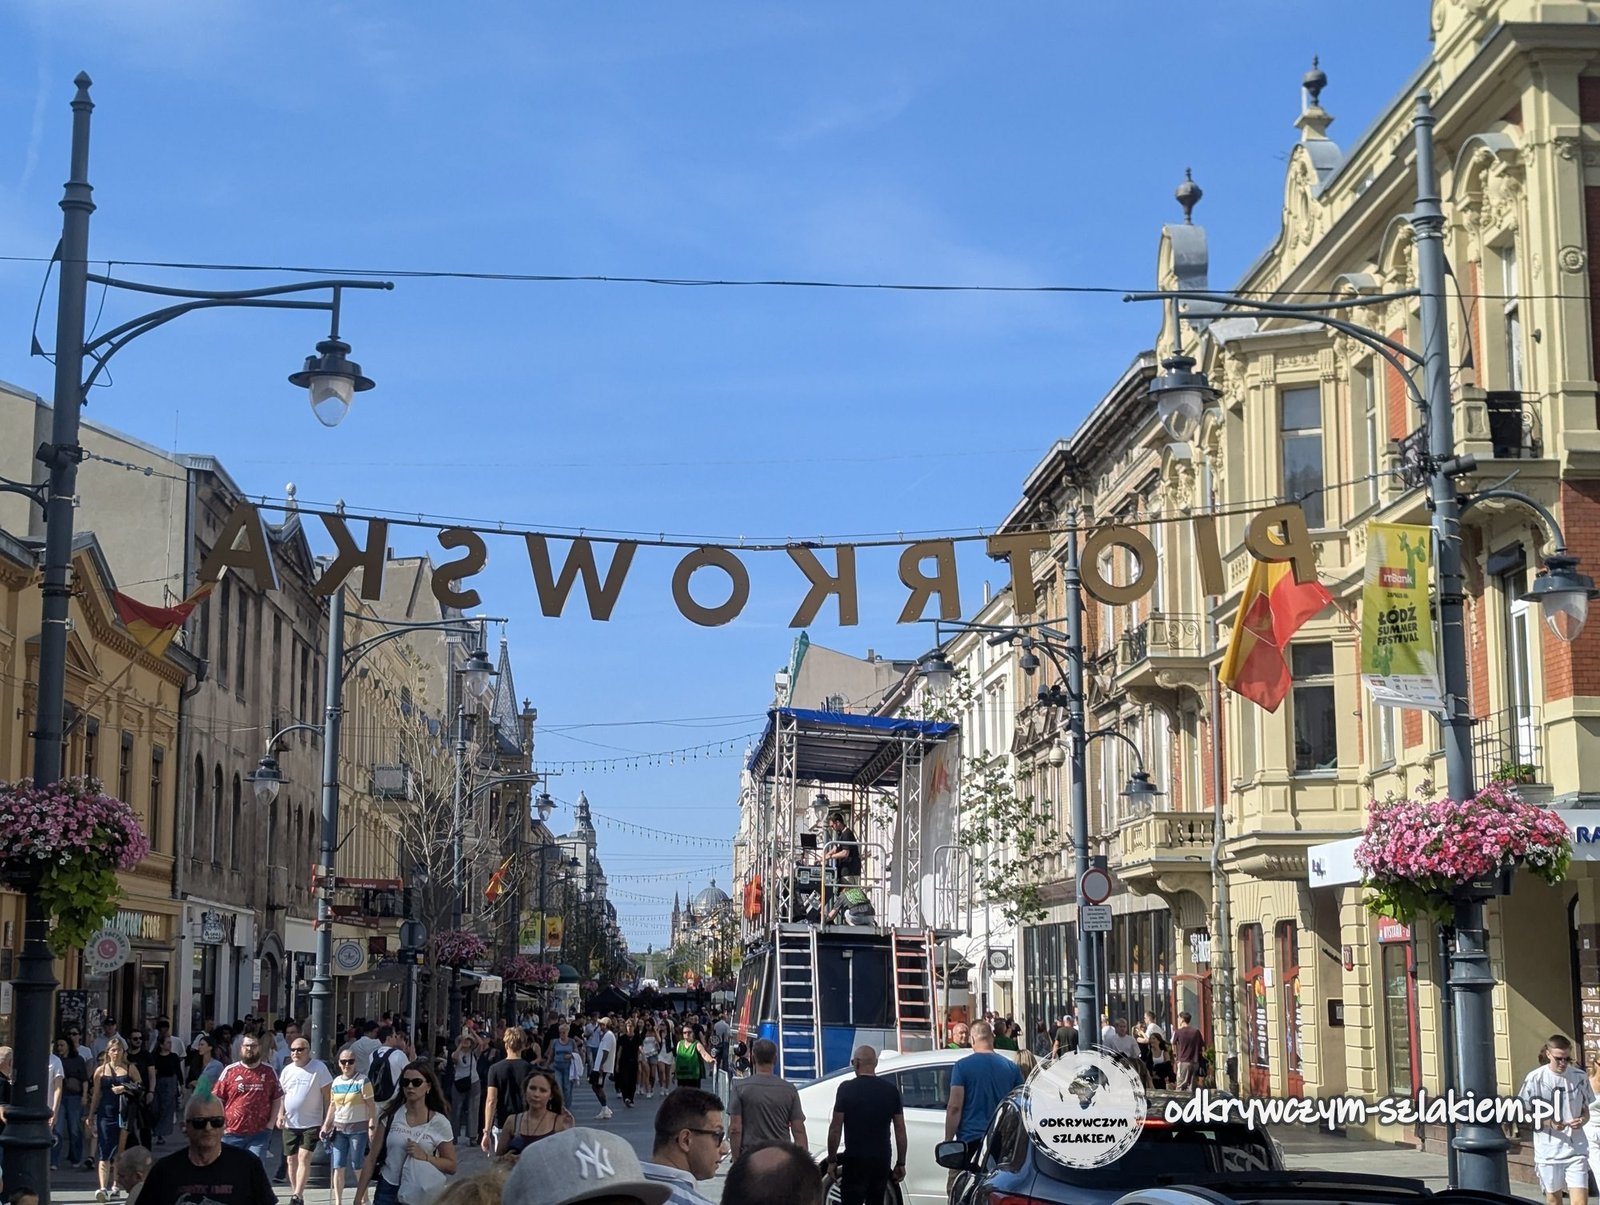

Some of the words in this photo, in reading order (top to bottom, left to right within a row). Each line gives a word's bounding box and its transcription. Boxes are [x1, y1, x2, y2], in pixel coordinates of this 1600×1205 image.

[1382, 572, 1414, 586] mBank
[1378, 602, 1417, 625] ŁÓDŹ
[1377, 622, 1418, 636] SUMMER
[1377, 633, 1419, 647] FESTIVAL
[142, 915, 160, 938] STORE
[95, 960, 118, 969] STORE
[574, 1140, 616, 1180] NY
